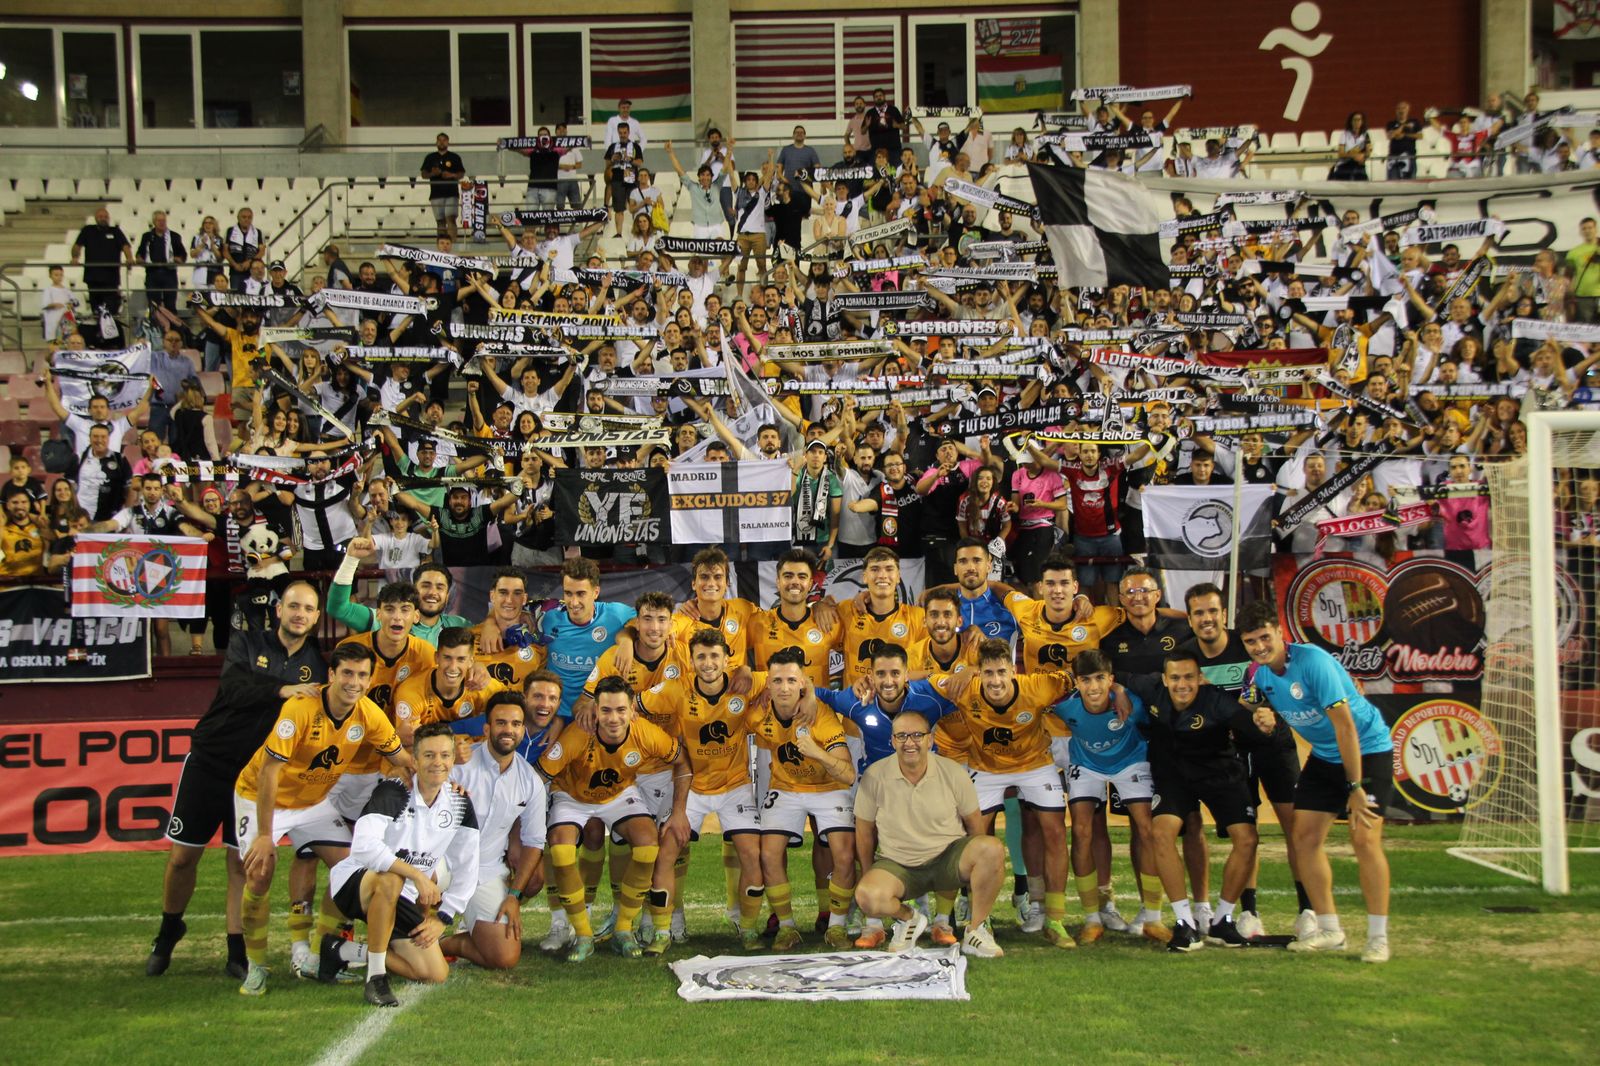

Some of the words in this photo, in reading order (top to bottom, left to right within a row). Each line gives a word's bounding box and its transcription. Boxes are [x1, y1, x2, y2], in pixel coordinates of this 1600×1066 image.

[667, 239, 735, 252] UNIONISTAS
[399, 249, 476, 269] UNIONISTAS
[608, 326, 658, 337] POPULAR
[350, 347, 395, 359] FUTBOL
[396, 346, 447, 359] POPULAR
[819, 349, 832, 357] DE
[1250, 413, 1315, 425] POPULAR
[1084, 431, 1099, 440] SE
[1102, 431, 1142, 440] RINDE
[671, 471, 718, 482] MADRID
[671, 493, 768, 509] EXCLUIDOS
[772, 491, 789, 506] 37
[1285, 498, 1318, 529] Against
[1318, 473, 1352, 503] Modern
[575, 517, 661, 543] UNIONISTAS
[741, 521, 790, 529] SALAMANCA
[1318, 591, 1347, 623] SDL
[11, 655, 51, 668] OSKAR
[1387, 644, 1478, 673] Modern
[1394, 728, 1406, 776] SOCIEDAD
[1405, 704, 1456, 729] DEPORTIVA
[1410, 736, 1446, 769] SDL
[239, 815, 250, 837] 8
